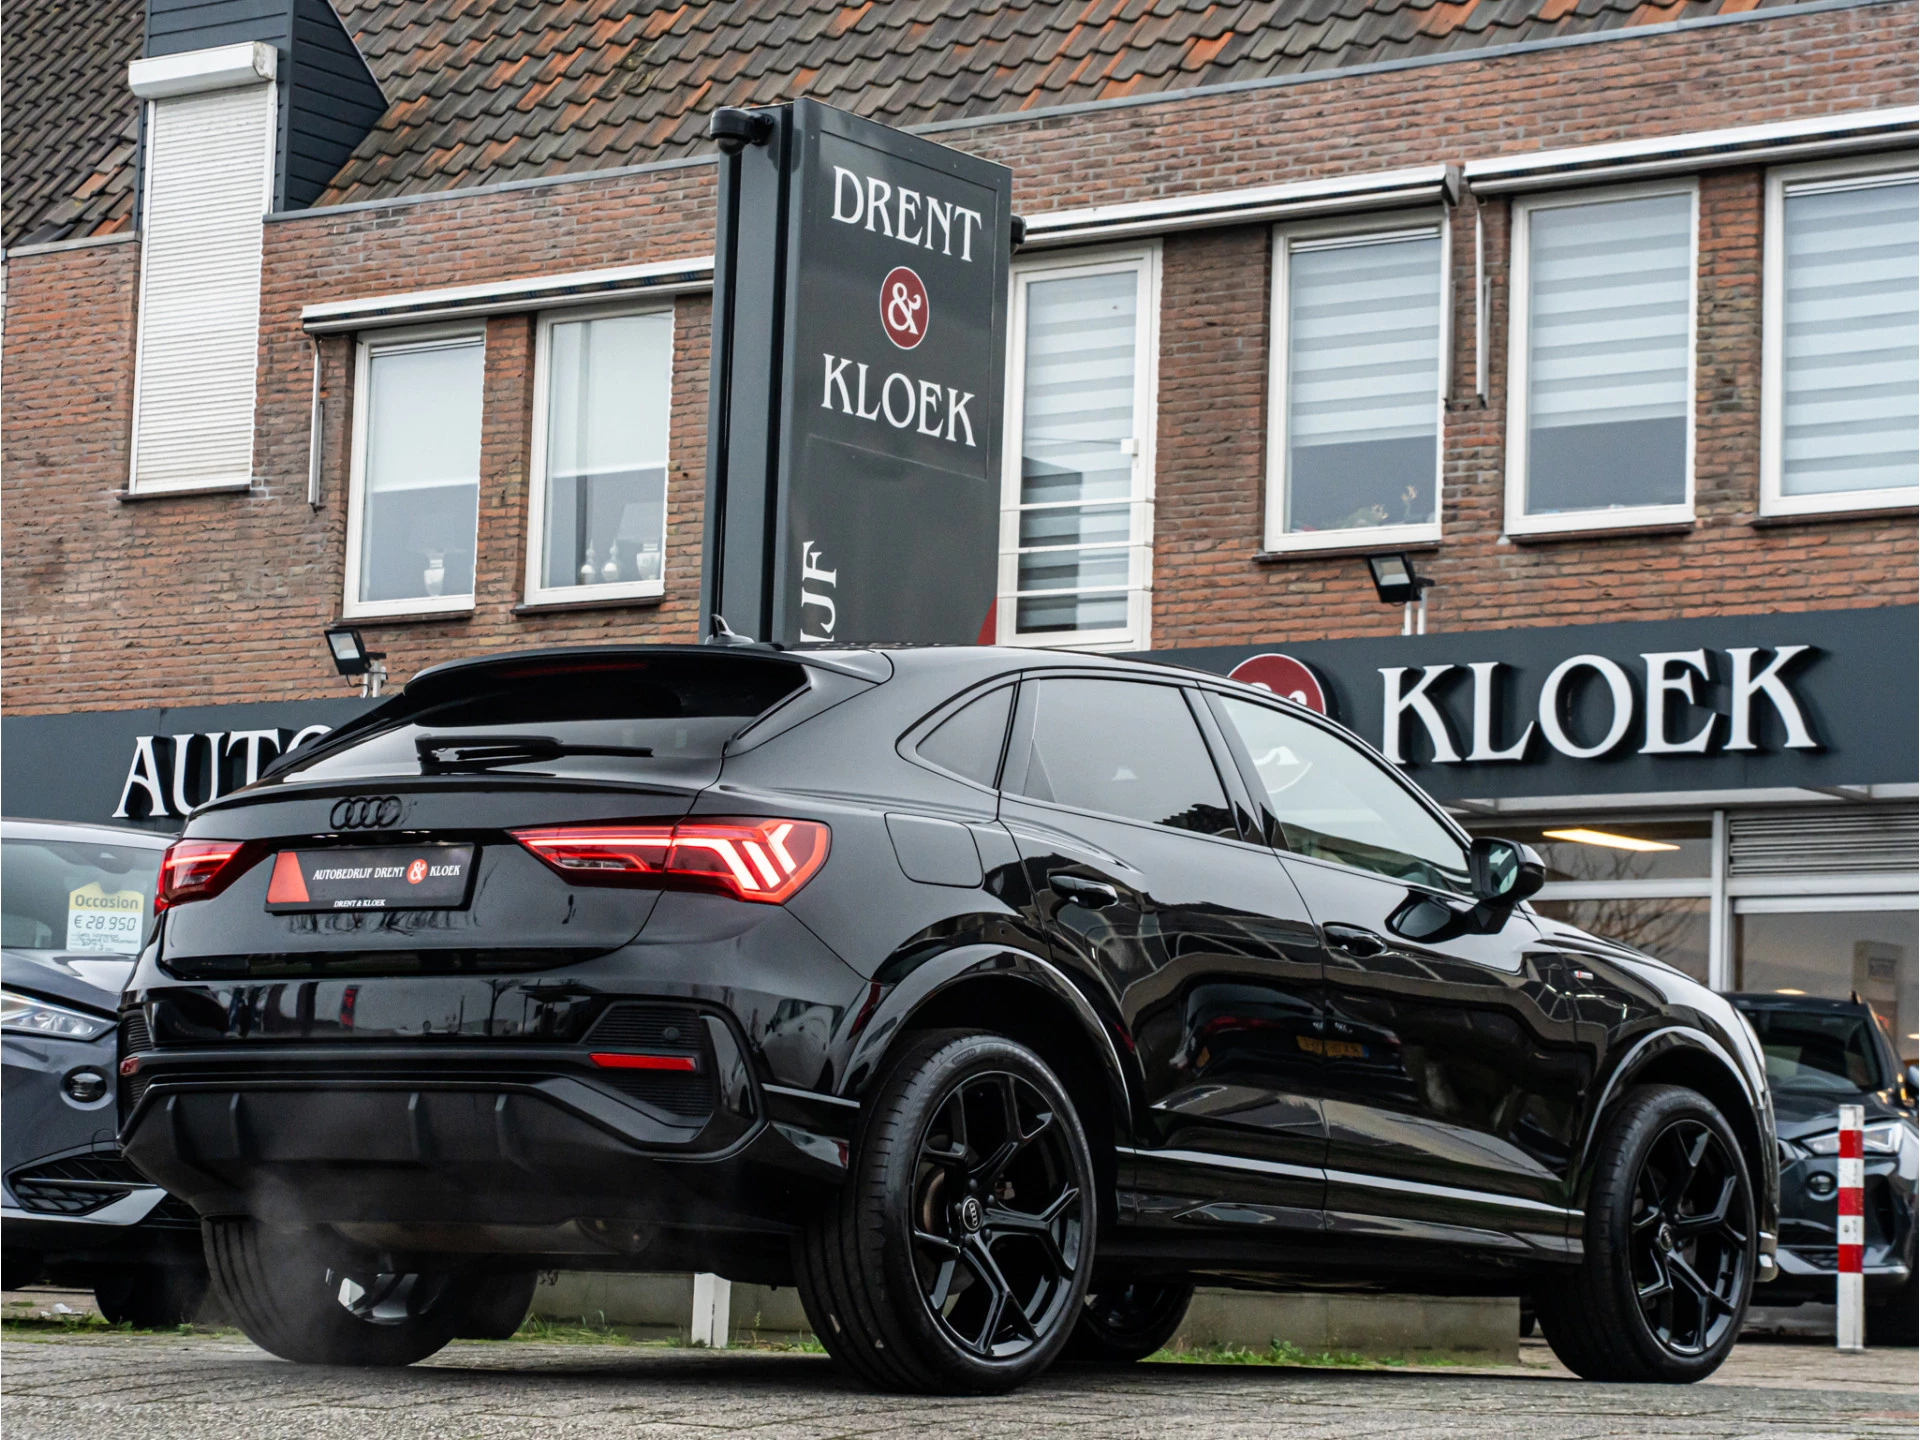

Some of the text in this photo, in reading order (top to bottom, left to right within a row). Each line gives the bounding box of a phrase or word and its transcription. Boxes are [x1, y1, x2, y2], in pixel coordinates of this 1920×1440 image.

[831, 165, 982, 262] DRENT
[888, 282, 921, 335] &
[820, 353, 976, 447] KLOEK
[1377, 644, 1819, 765] KLOEK
[313, 861, 461, 881] AUTOBEDRIJF DRENT & KLOEK
[75, 894, 139, 910] Occasion
[333, 900, 357, 908] DRENT
[363, 899, 386, 907] KLOEK
[74, 915, 137, 932] € 28.950
